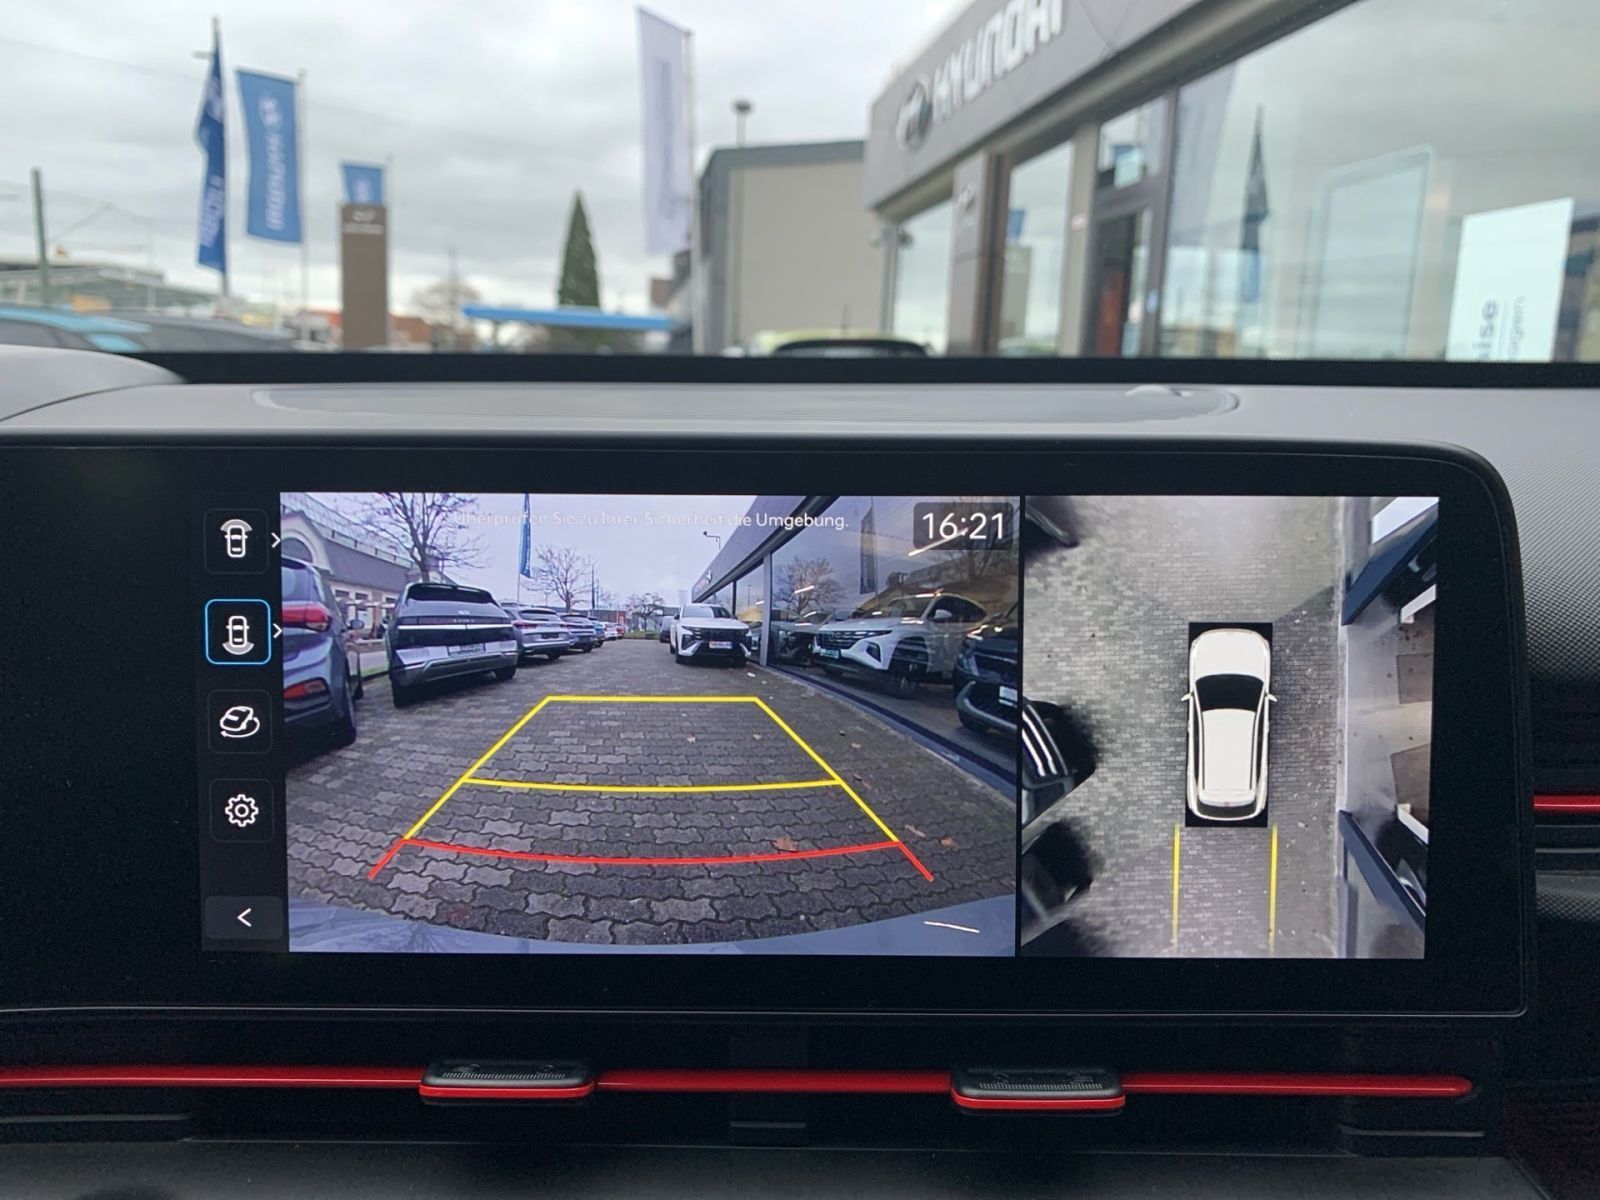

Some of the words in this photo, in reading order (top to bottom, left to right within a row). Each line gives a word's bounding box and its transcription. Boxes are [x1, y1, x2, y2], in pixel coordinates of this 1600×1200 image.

[552, 511, 577, 525] Sie
[578, 514, 598, 525] zu
[601, 511, 638, 526] Ihrer
[644, 511, 723, 526] Sicherheit
[728, 512, 752, 527] die
[755, 513, 849, 531] Umgebung.
[922, 512, 1004, 540] 16:21
